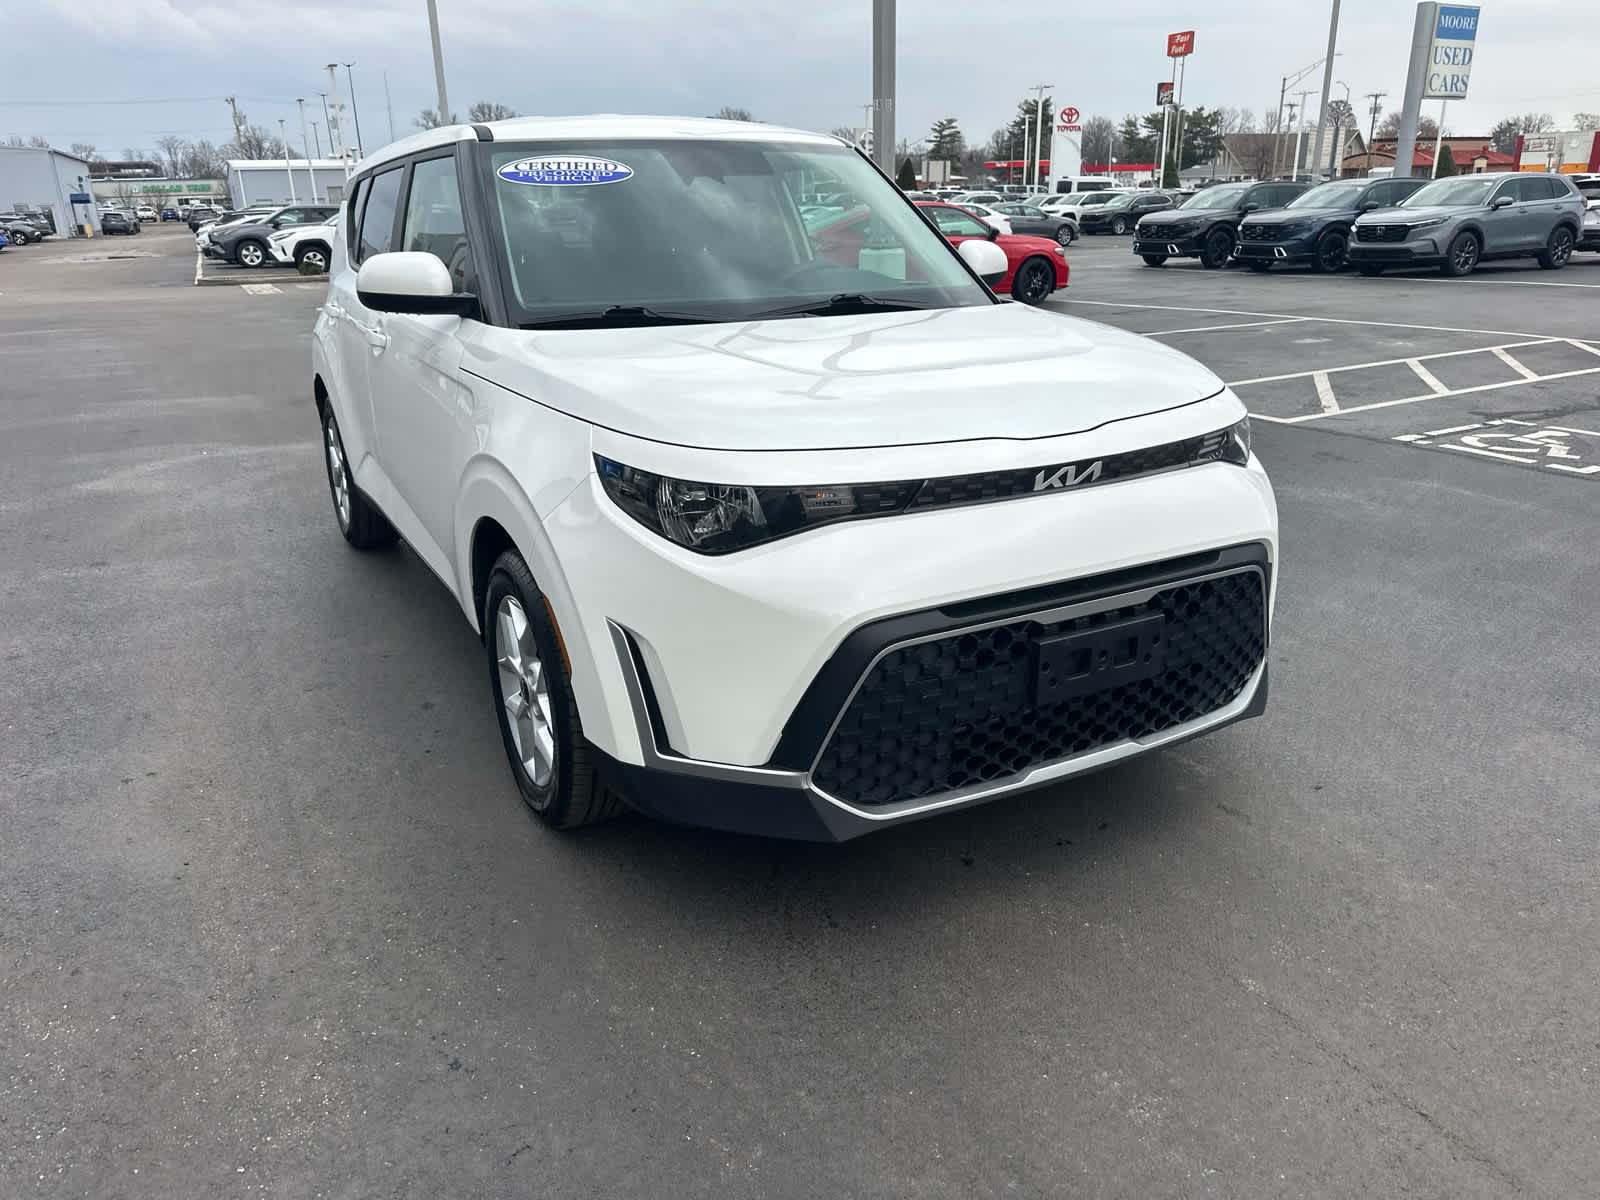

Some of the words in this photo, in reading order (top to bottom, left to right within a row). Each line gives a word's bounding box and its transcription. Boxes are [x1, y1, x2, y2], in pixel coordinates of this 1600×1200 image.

[1440, 15, 1477, 30] MOORE
[1433, 46, 1473, 66] USED
[1429, 72, 1469, 92] CARS
[514, 161, 618, 171] CERTIFIED
[1033, 461, 1103, 491] KIA
